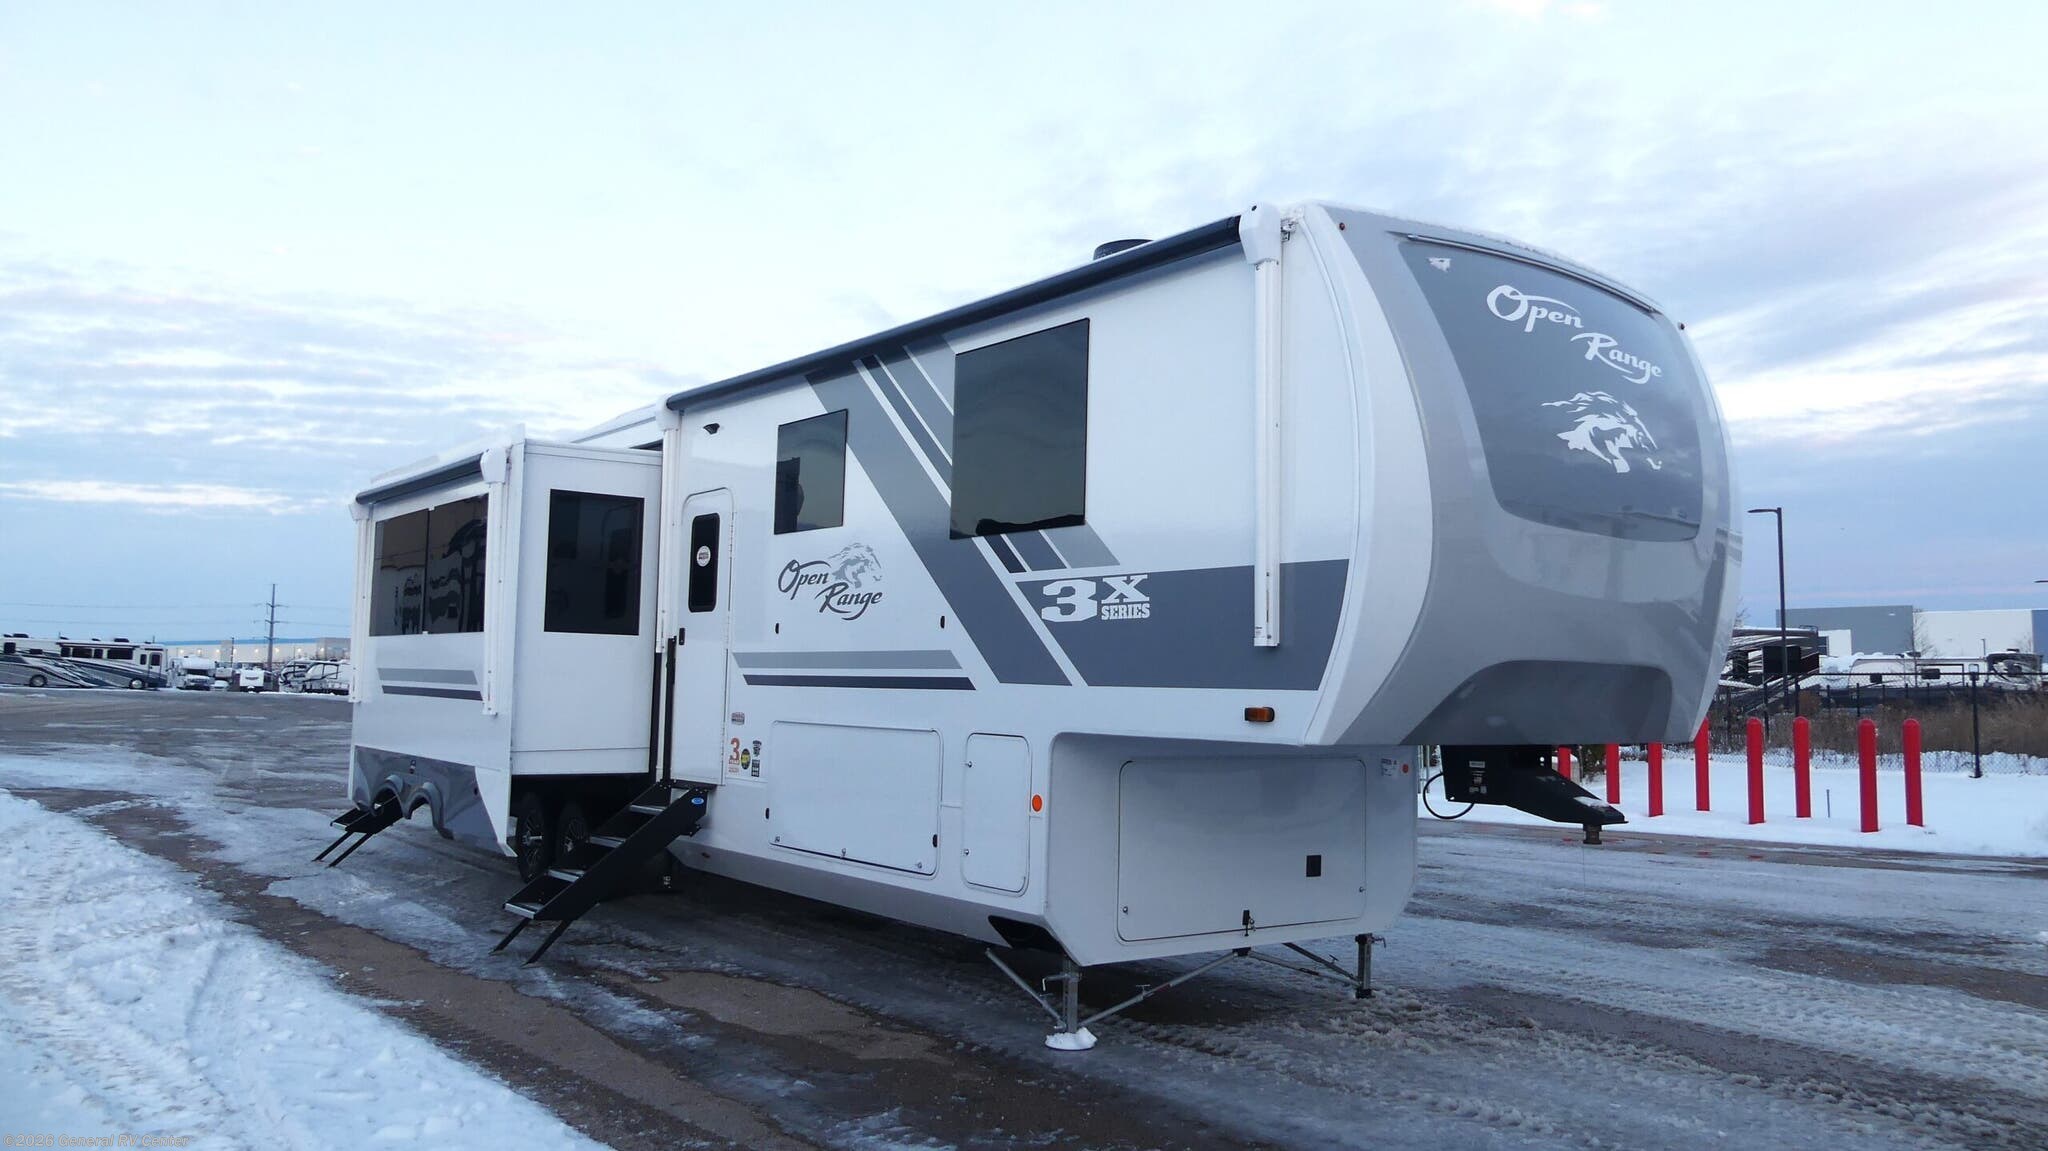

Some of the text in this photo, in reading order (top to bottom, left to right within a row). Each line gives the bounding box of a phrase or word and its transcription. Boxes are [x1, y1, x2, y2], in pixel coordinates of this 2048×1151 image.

[1486, 284, 1584, 333] Open
[1570, 332, 1662, 384] Range
[778, 559, 831, 600] Open
[814, 582, 883, 620] Range
[1101, 603, 1150, 620] SERIES
